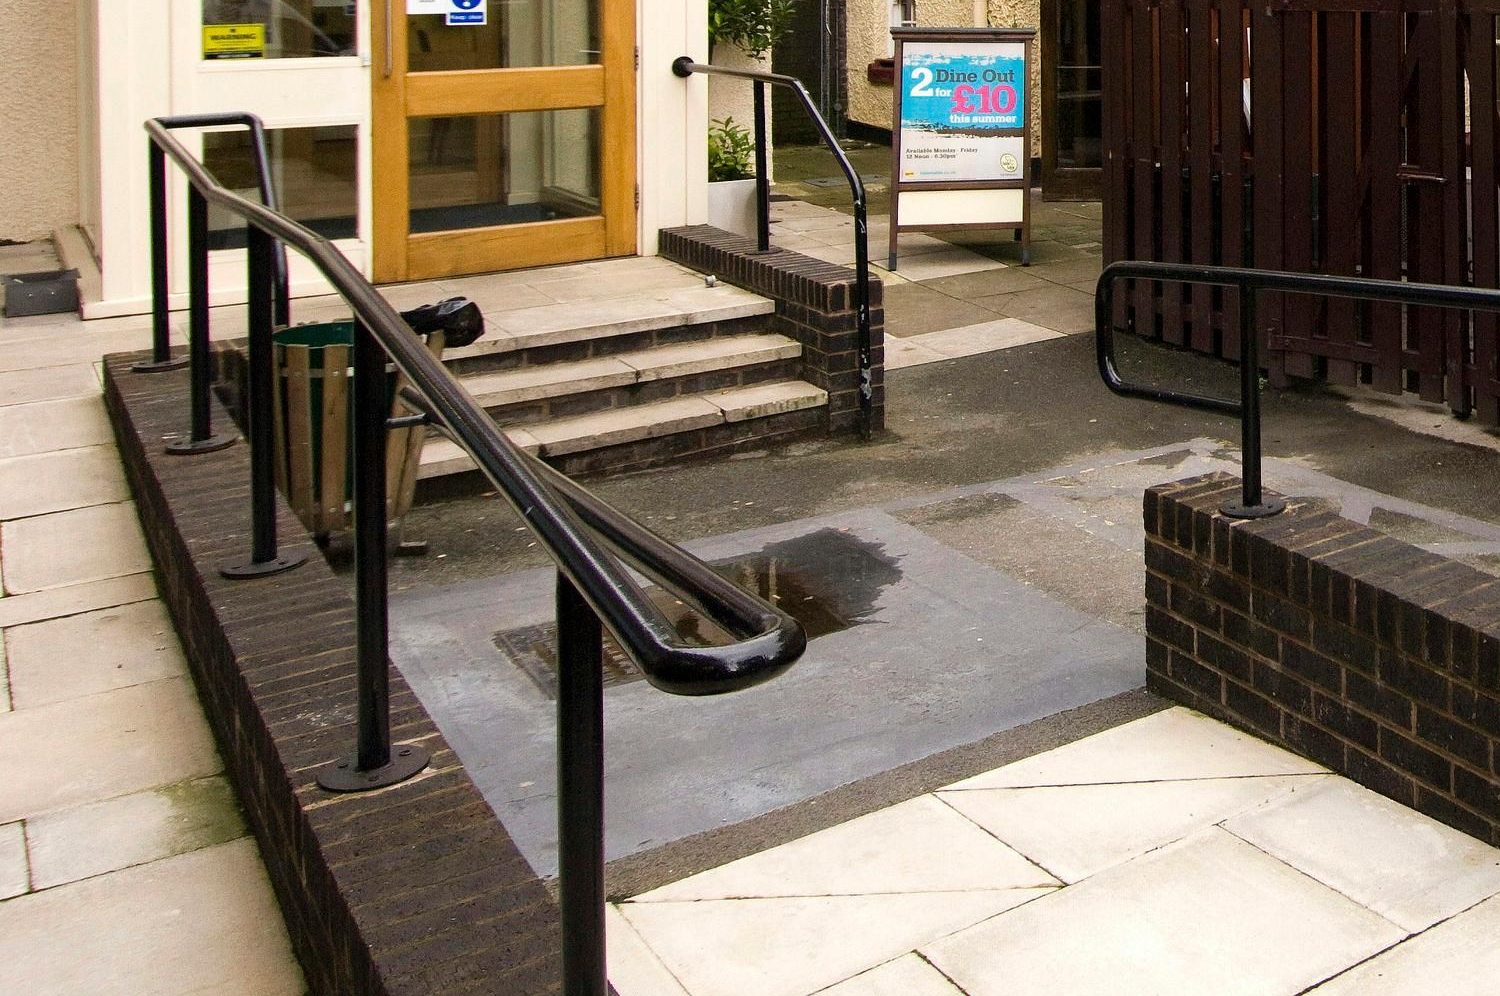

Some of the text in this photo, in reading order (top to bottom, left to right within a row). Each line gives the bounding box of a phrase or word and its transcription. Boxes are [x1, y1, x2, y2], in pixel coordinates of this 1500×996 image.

[210, 33, 257, 41] WARNING
[910, 67, 1015, 97] 2 Dine Out
[935, 84, 1017, 114] for £10
[950, 114, 1017, 123] this summer
